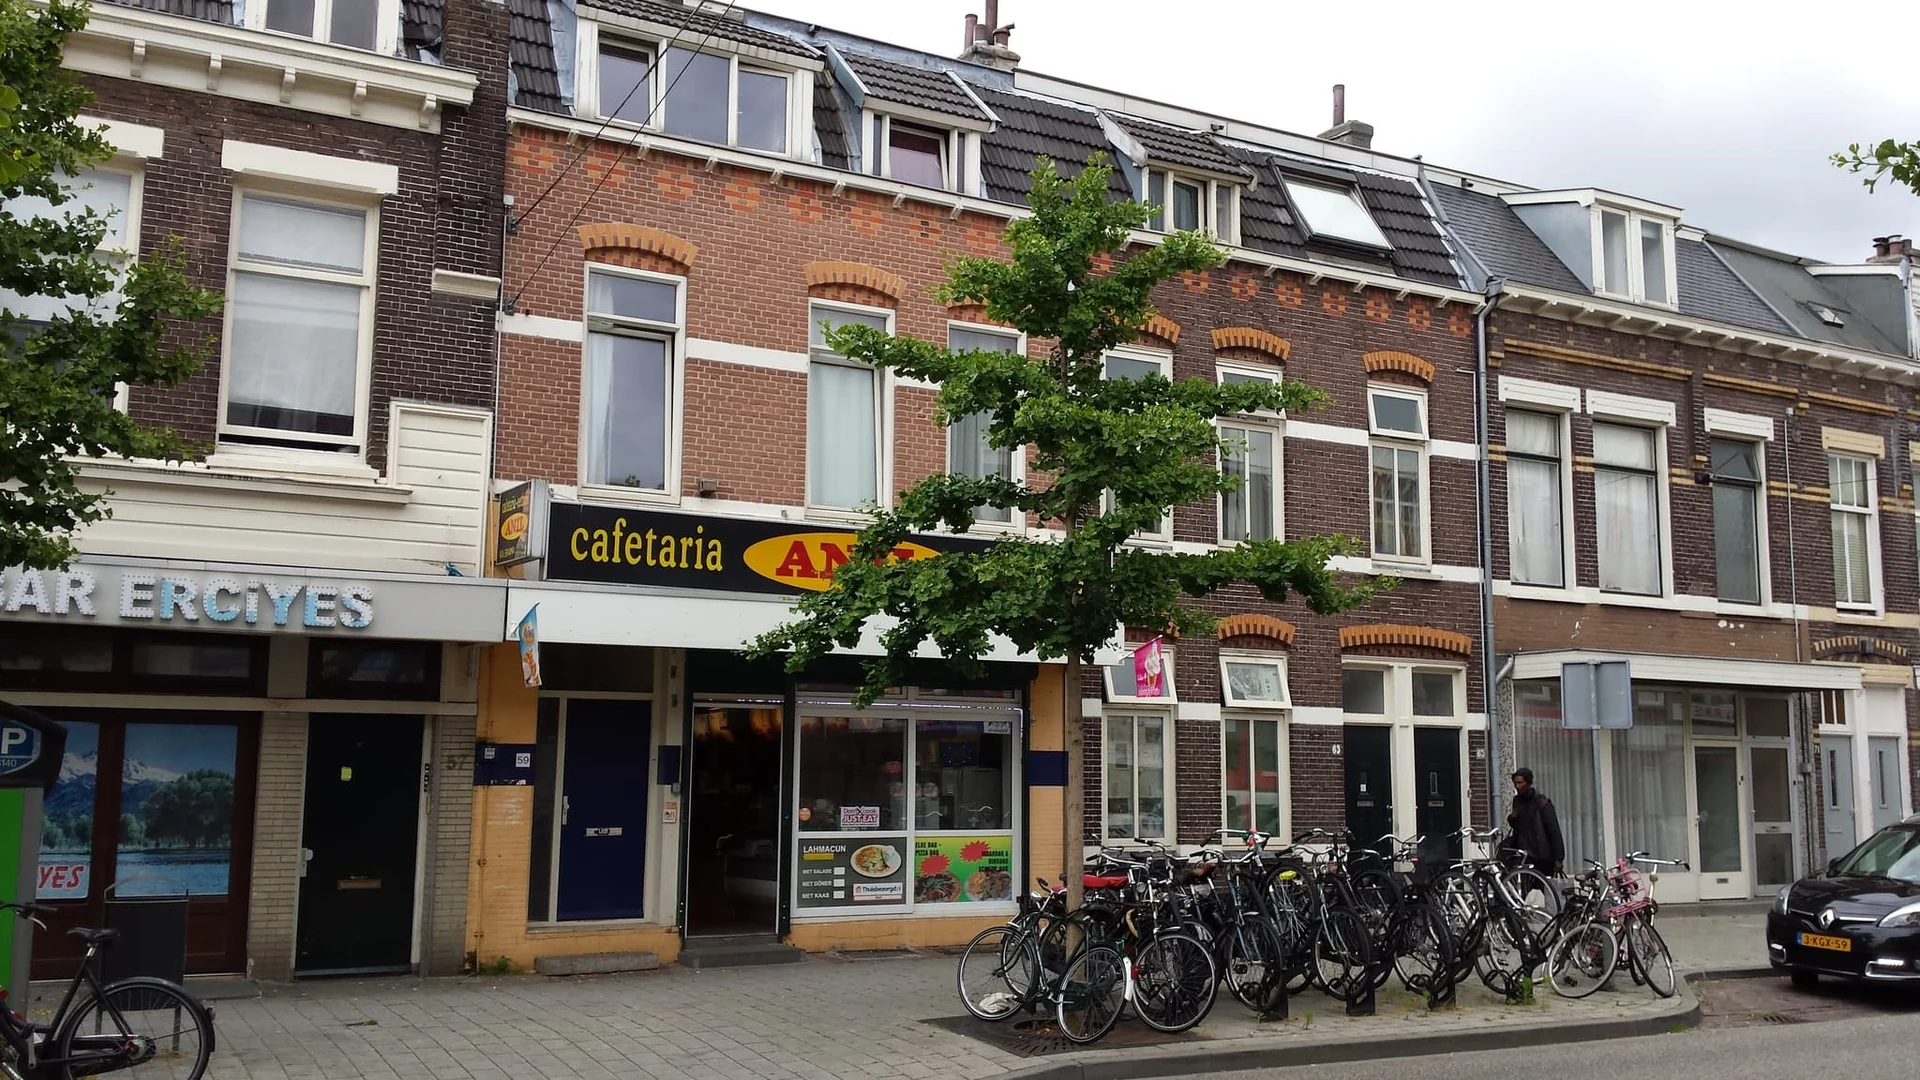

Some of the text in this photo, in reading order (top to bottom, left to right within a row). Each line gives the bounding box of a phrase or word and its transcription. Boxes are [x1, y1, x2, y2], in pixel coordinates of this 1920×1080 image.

[571, 517, 915, 580] cafetaria AN
[0, 567, 97, 616] AR
[1, 727, 27, 754] P
[446, 753, 468, 770] 57
[517, 755, 529, 765] 59
[803, 845, 847, 853] LAHMACUN
[1803, 934, 1848, 950] 3-KGX-59
